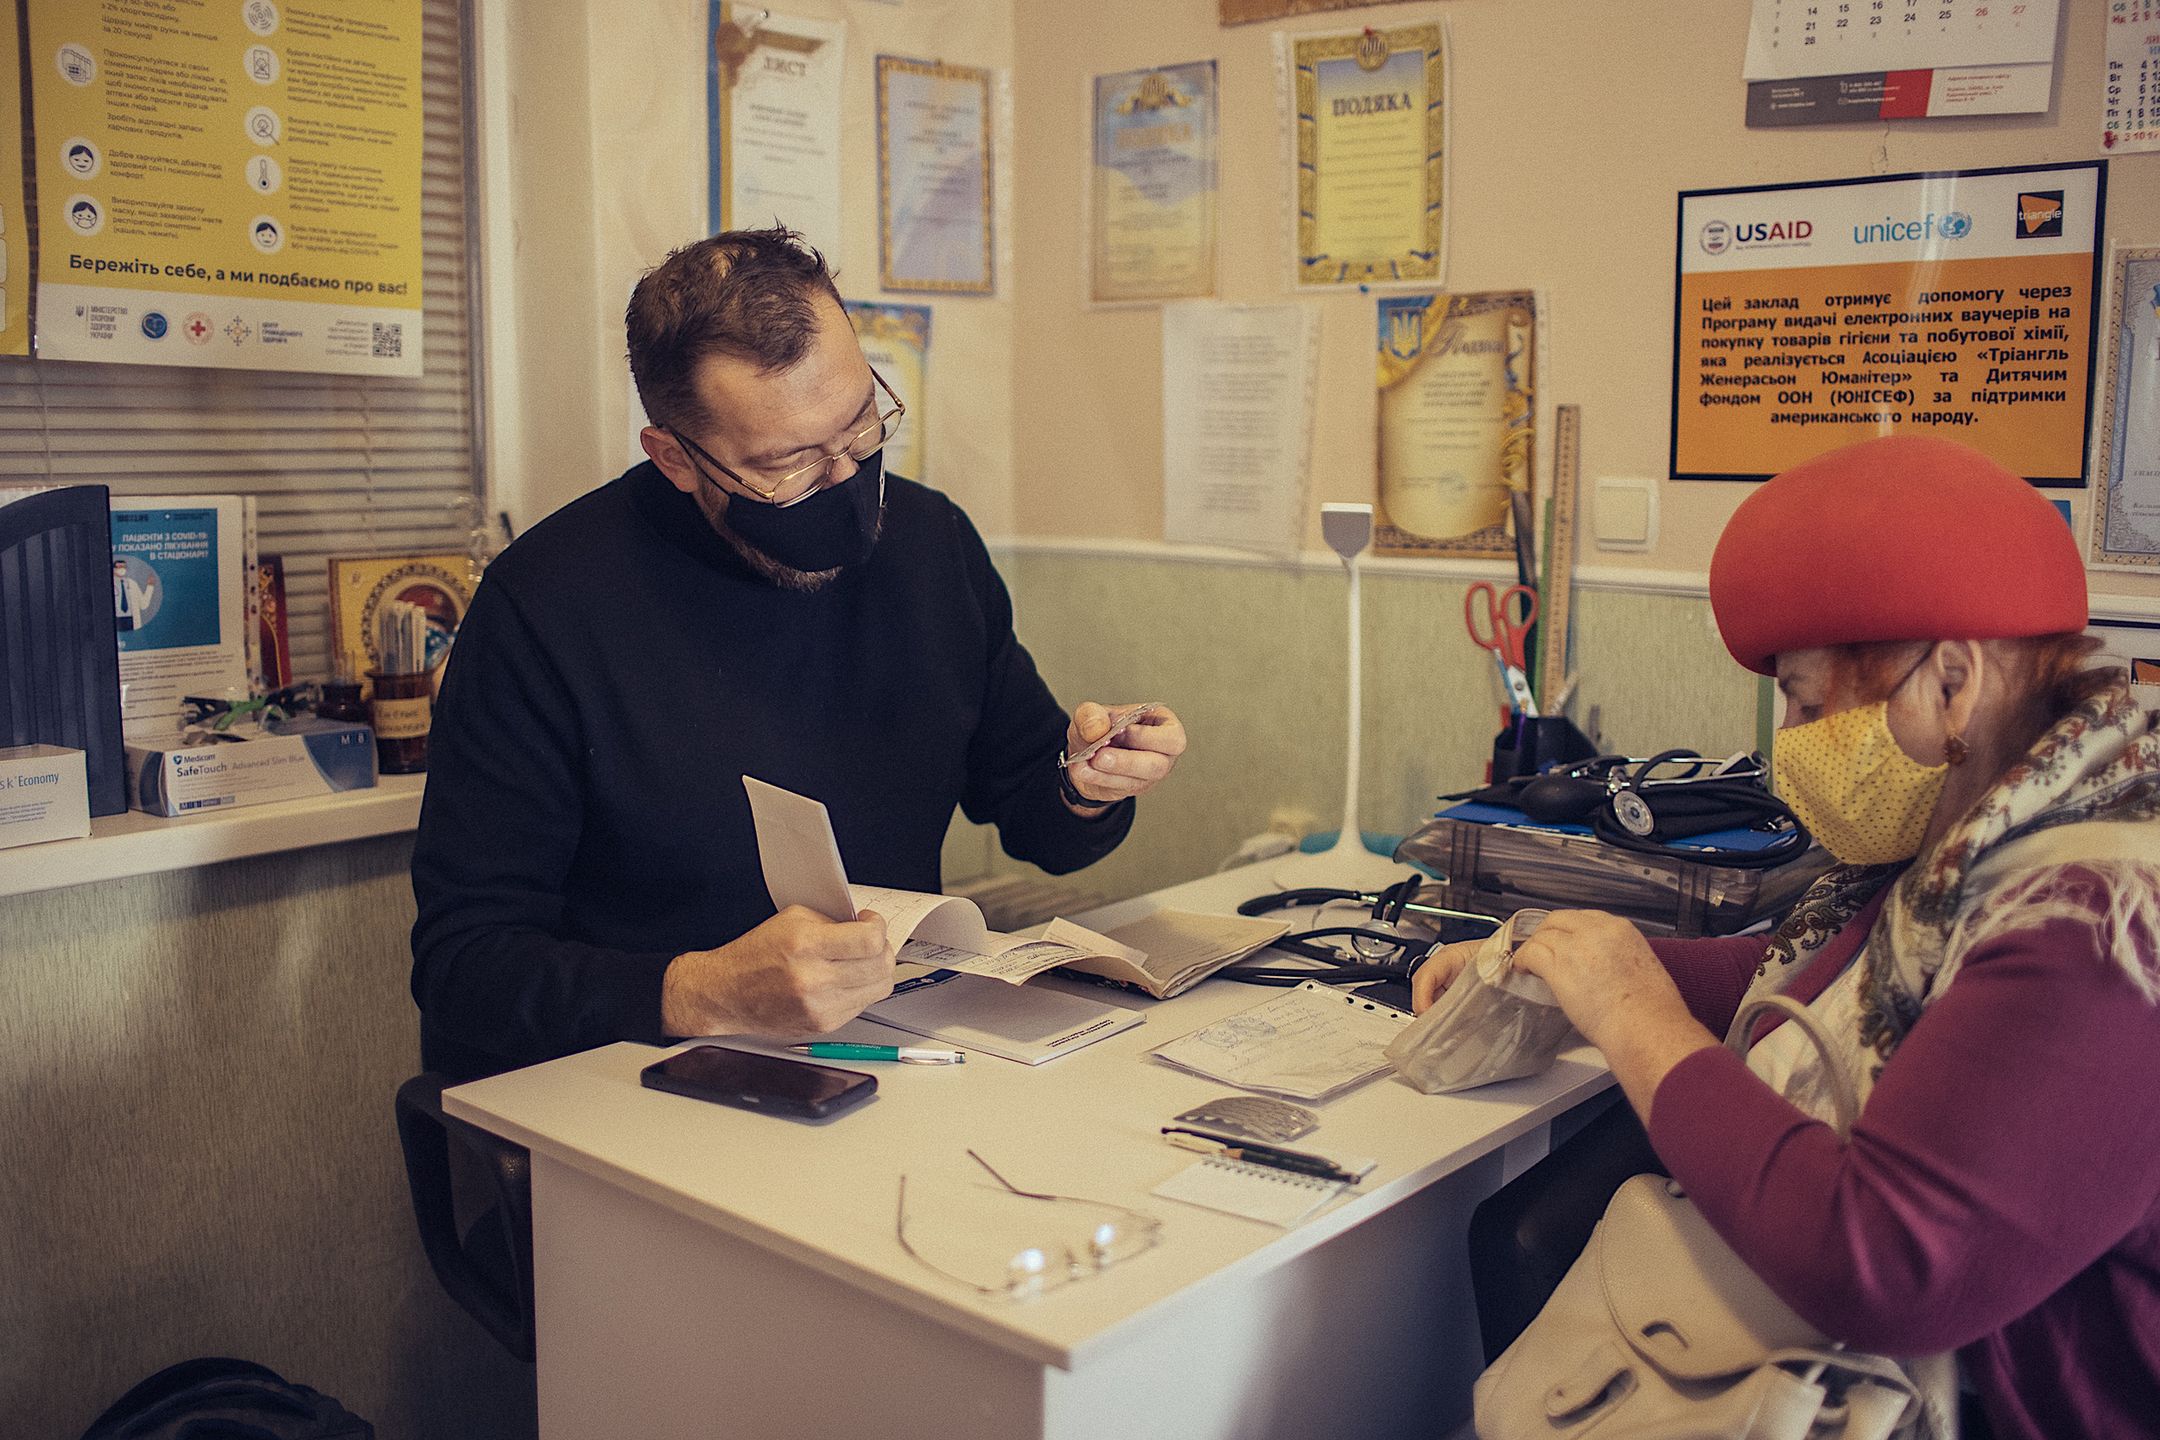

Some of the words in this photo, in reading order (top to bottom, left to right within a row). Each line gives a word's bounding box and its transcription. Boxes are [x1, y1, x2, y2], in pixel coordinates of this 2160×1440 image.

[1808, 7, 1817, 15] 14
[1840, 4, 1849, 12] 15
[1873, 1, 1883, 10] 16
[1806, 22, 1816, 30] 21
[1837, 19, 1848, 27] 22
[1870, 16, 1881, 25] 23
[1904, 13, 1916, 22] 24
[1939, 10, 1951, 19] 25
[1976, 7, 1988, 16] 26
[2013, 5, 2026, 14] 27
[2141, 60, 2147, 69] 4
[2141, 72, 2146, 81] 5
[2108, 85, 2121, 94] Ср
[2140, 84, 2145, 94] 6
[1332, 92, 1412, 116] ПОДЯКА
[2108, 97, 2120, 105] Чт
[2139, 96, 2145, 105] 7
[2127, 109, 2131, 118] 1
[2138, 108, 2144, 118] 8
[2107, 121, 2120, 129] Сб
[2127, 121, 2132, 130] 2
[2134, 132, 2145, 140] 10
[2018, 209, 2062, 222] triangle
[1736, 221, 1812, 242] USAID
[1854, 213, 1934, 244] unicef
[70, 255, 160, 275] Бережіть
[164, 264, 211, 281] себе,
[216, 270, 225, 280] а
[230, 272, 253, 282] ми
[259, 273, 339, 289] подбаємо
[345, 280, 373, 293] про
[378, 282, 407, 295] вас!
[1702, 296, 1731, 313] Цей
[1744, 297, 1799, 310] заклад
[1825, 293, 1892, 309] отримує
[1918, 289, 2005, 305] допомогу
[2020, 286, 2072, 301] через
[1702, 317, 1777, 332] Програму
[1784, 312, 1837, 328] видачі
[1844, 310, 1953, 327] електронних
[1961, 306, 2040, 323] ваучерів
[2049, 307, 2070, 318] на
[1702, 337, 1764, 350] покупку
[1771, 332, 1831, 348] товарів
[1840, 331, 1890, 345] гігієни
[1900, 332, 1918, 343] та
[1927, 327, 2015, 345] побутової
[2024, 325, 2069, 342] хімії,
[1701, 357, 1727, 367] яка
[1744, 352, 1845, 369] реалізується
[1863, 350, 1957, 365] Асоціацією
[1977, 348, 2069, 364] «Тріангль
[1700, 373, 1797, 387] Женерасьон
[1822, 370, 1912, 386] Юманітер»
[1940, 371, 1958, 382] та
[1986, 368, 2067, 384] Дитячим
[1700, 392, 1761, 407] фондом
[1778, 391, 1812, 404] ООН
[1830, 389, 1914, 406] (ЮНІСЕФ)
[1933, 392, 1952, 403] за
[1972, 388, 2066, 405] підтримки
[1771, 411, 1901, 426] американського
[1911, 412, 1979, 425] народу.
[119, 543, 161, 551] ПОКАЗАНО
[341, 734, 350, 744] M
[184, 754, 215, 763] Medicom
[176, 762, 227, 777] SafeTouch
[233, 760, 270, 770] Advanced
[18, 773, 59, 787] Economy
